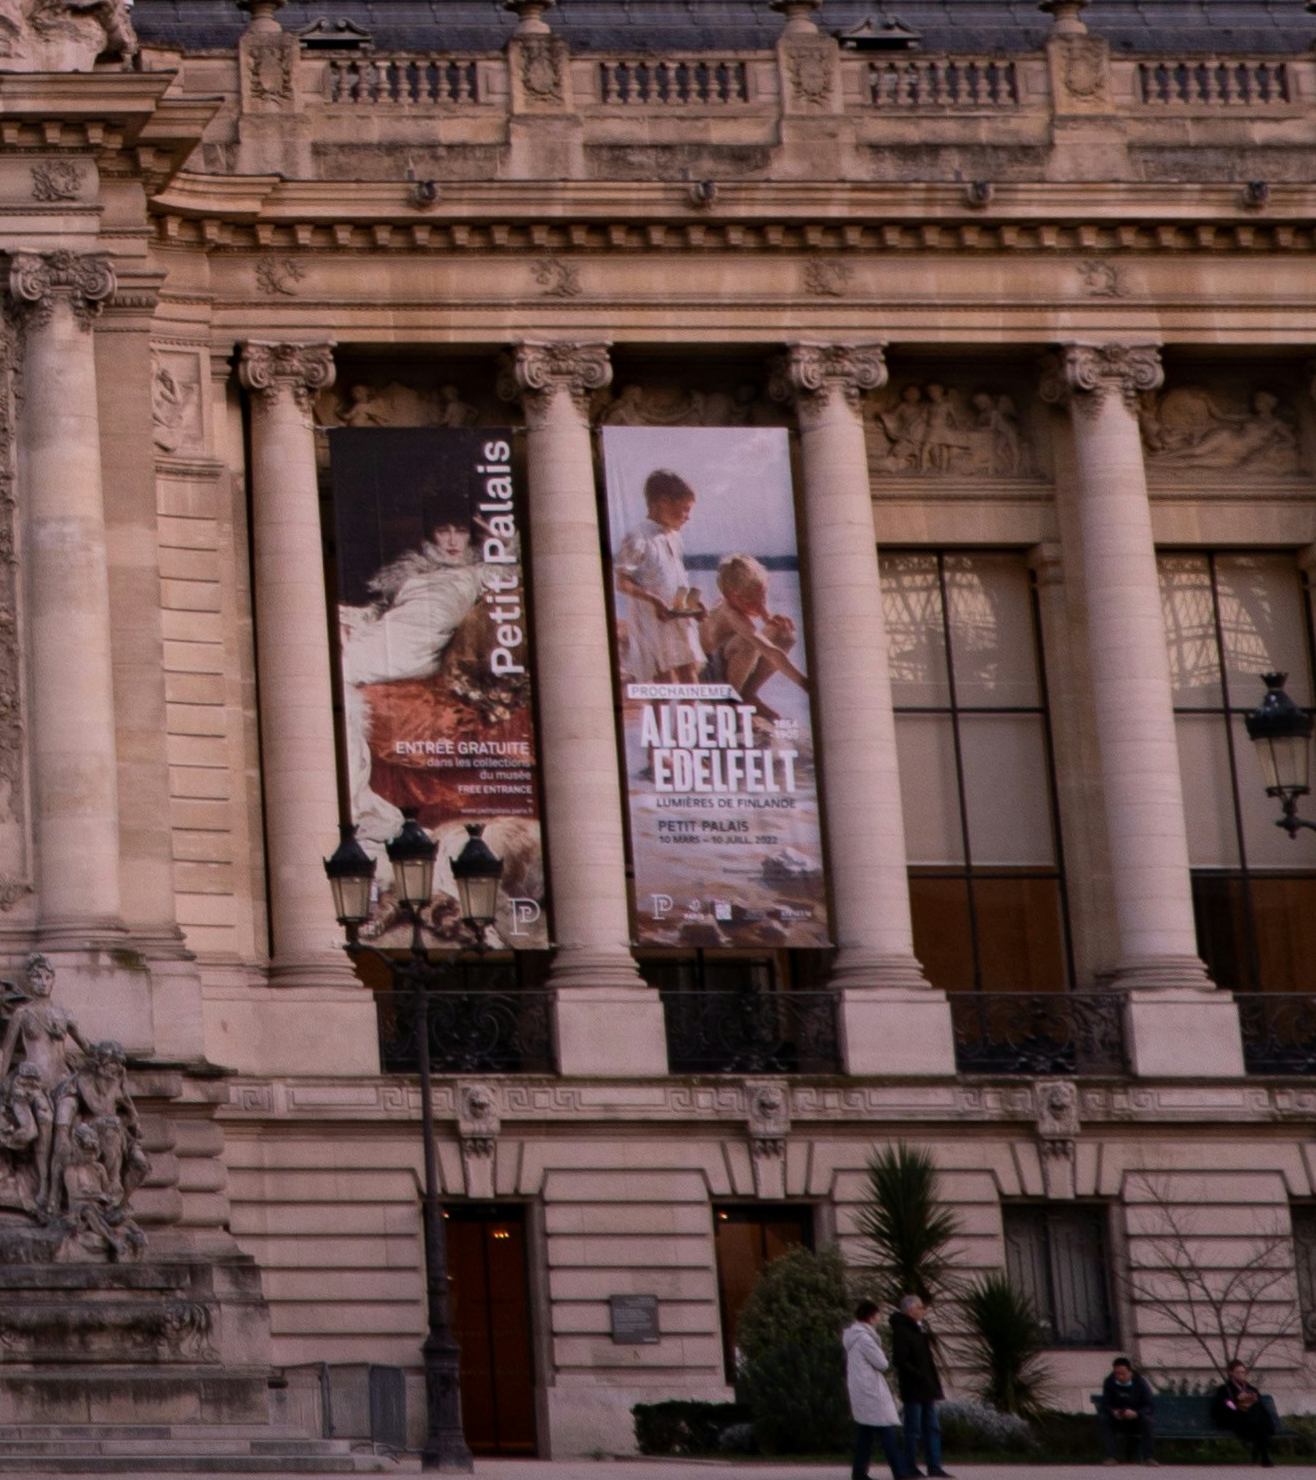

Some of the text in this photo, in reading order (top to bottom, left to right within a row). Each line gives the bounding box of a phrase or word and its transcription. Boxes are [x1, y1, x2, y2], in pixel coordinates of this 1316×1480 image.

[477, 440, 525, 676] Petit Palais
[641, 704, 757, 749] ALBERT
[395, 738, 530, 755] ENTRÉE GRATUITE
[427, 758, 531, 768] dans les collections
[479, 769, 532, 780] du musée
[653, 749, 799, 793] EDELFELT
[457, 784, 533, 795] FREE ENTRANCE
[656, 795, 796, 809] LUMIÈRES DE FINLANDE
[658, 820, 750, 832] PETIT PALAIS
[672, 835, 700, 844] MARS
